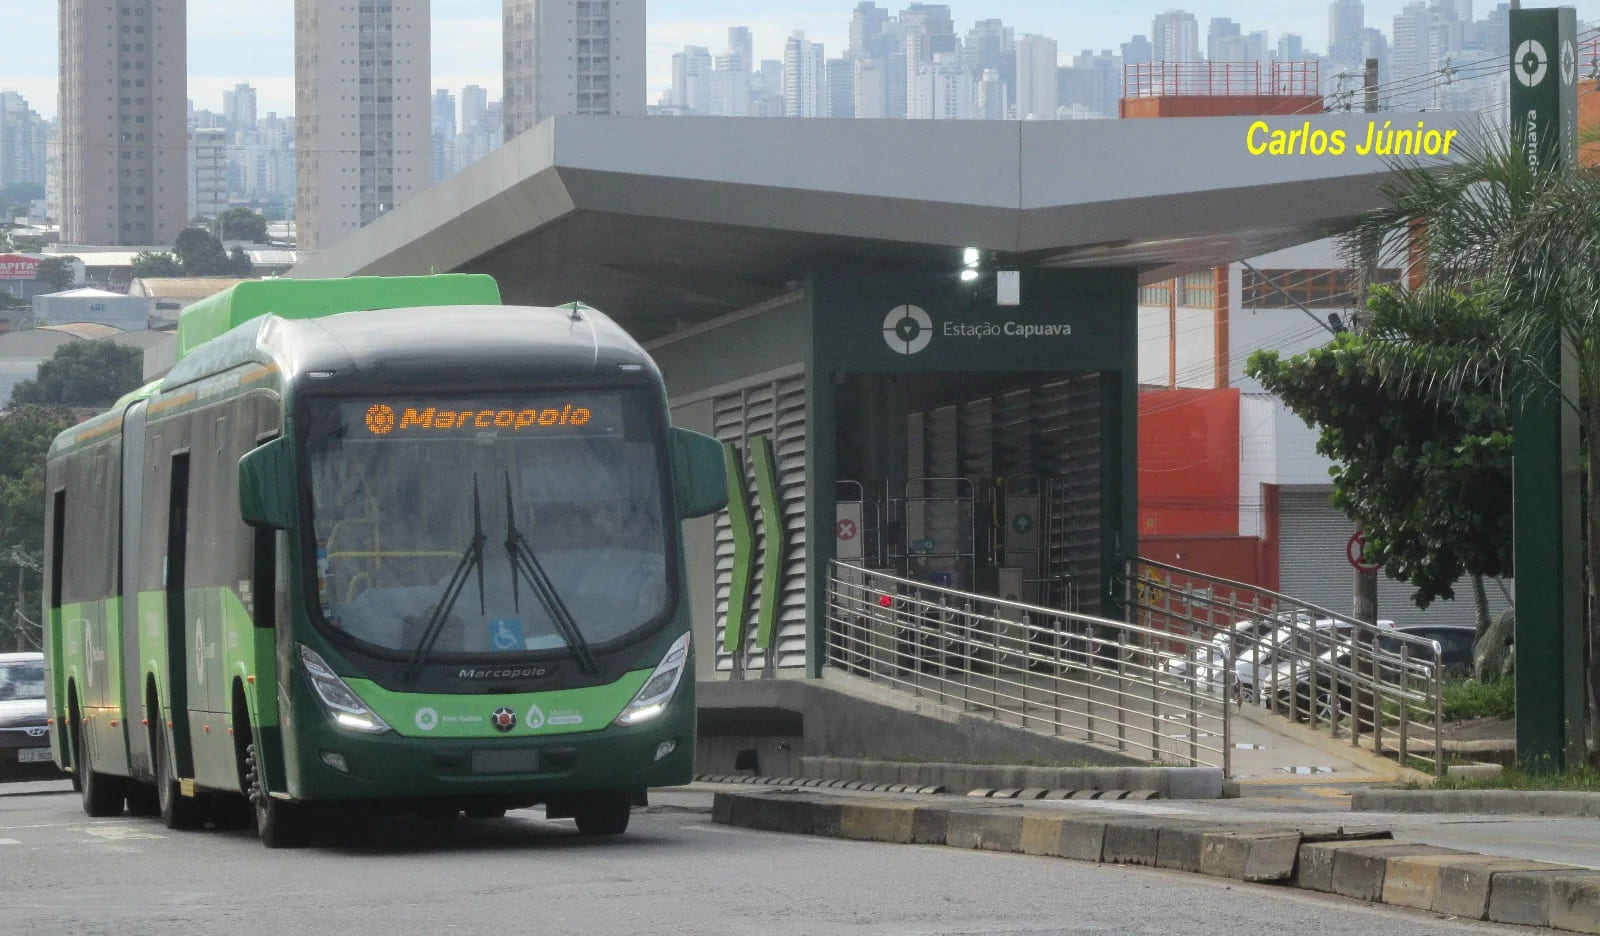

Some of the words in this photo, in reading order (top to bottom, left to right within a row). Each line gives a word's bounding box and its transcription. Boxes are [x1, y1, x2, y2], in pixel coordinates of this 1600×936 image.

[943, 321, 1000, 340] Estação
[1003, 321, 1072, 338] Capuava
[400, 403, 592, 431] Marcopolo
[458, 667, 546, 679] Marcopolo
